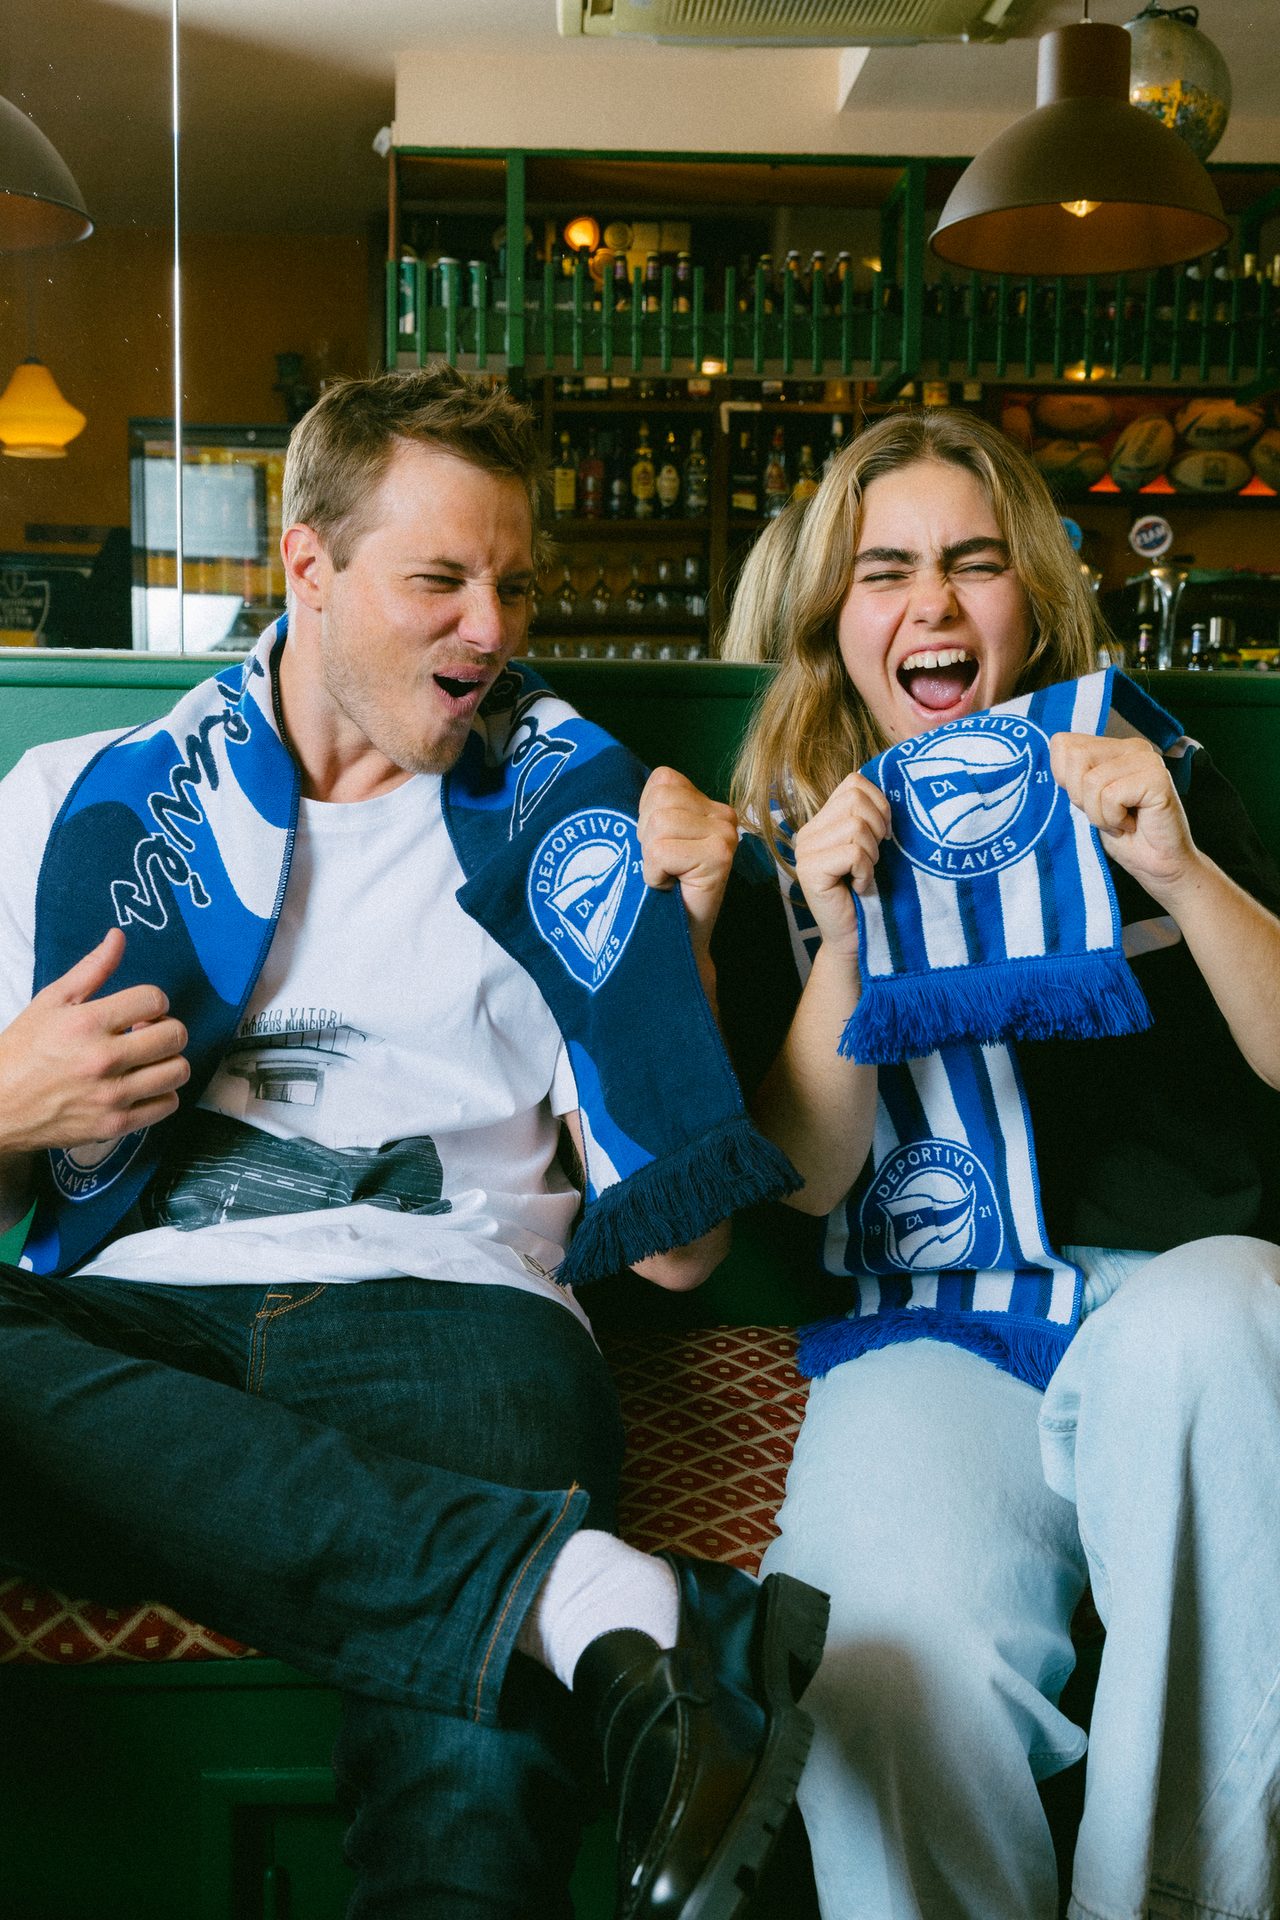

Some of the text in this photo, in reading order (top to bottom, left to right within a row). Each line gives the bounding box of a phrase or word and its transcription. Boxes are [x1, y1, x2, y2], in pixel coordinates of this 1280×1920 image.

[899, 717, 1029, 756] DEPORTIVO
[889, 770, 1048, 802] 19 21
[537, 817, 627, 893] DEPORTIVO
[928, 836, 1017, 869] ALAVÉS
[550, 926, 565, 942] 19
[592, 934, 620, 983] LAVÉS
[56, 1159, 98, 1193] ALAVÉS
[877, 1147, 975, 1199] DEPORTIVO
[869, 1206, 992, 1237] 19 21
